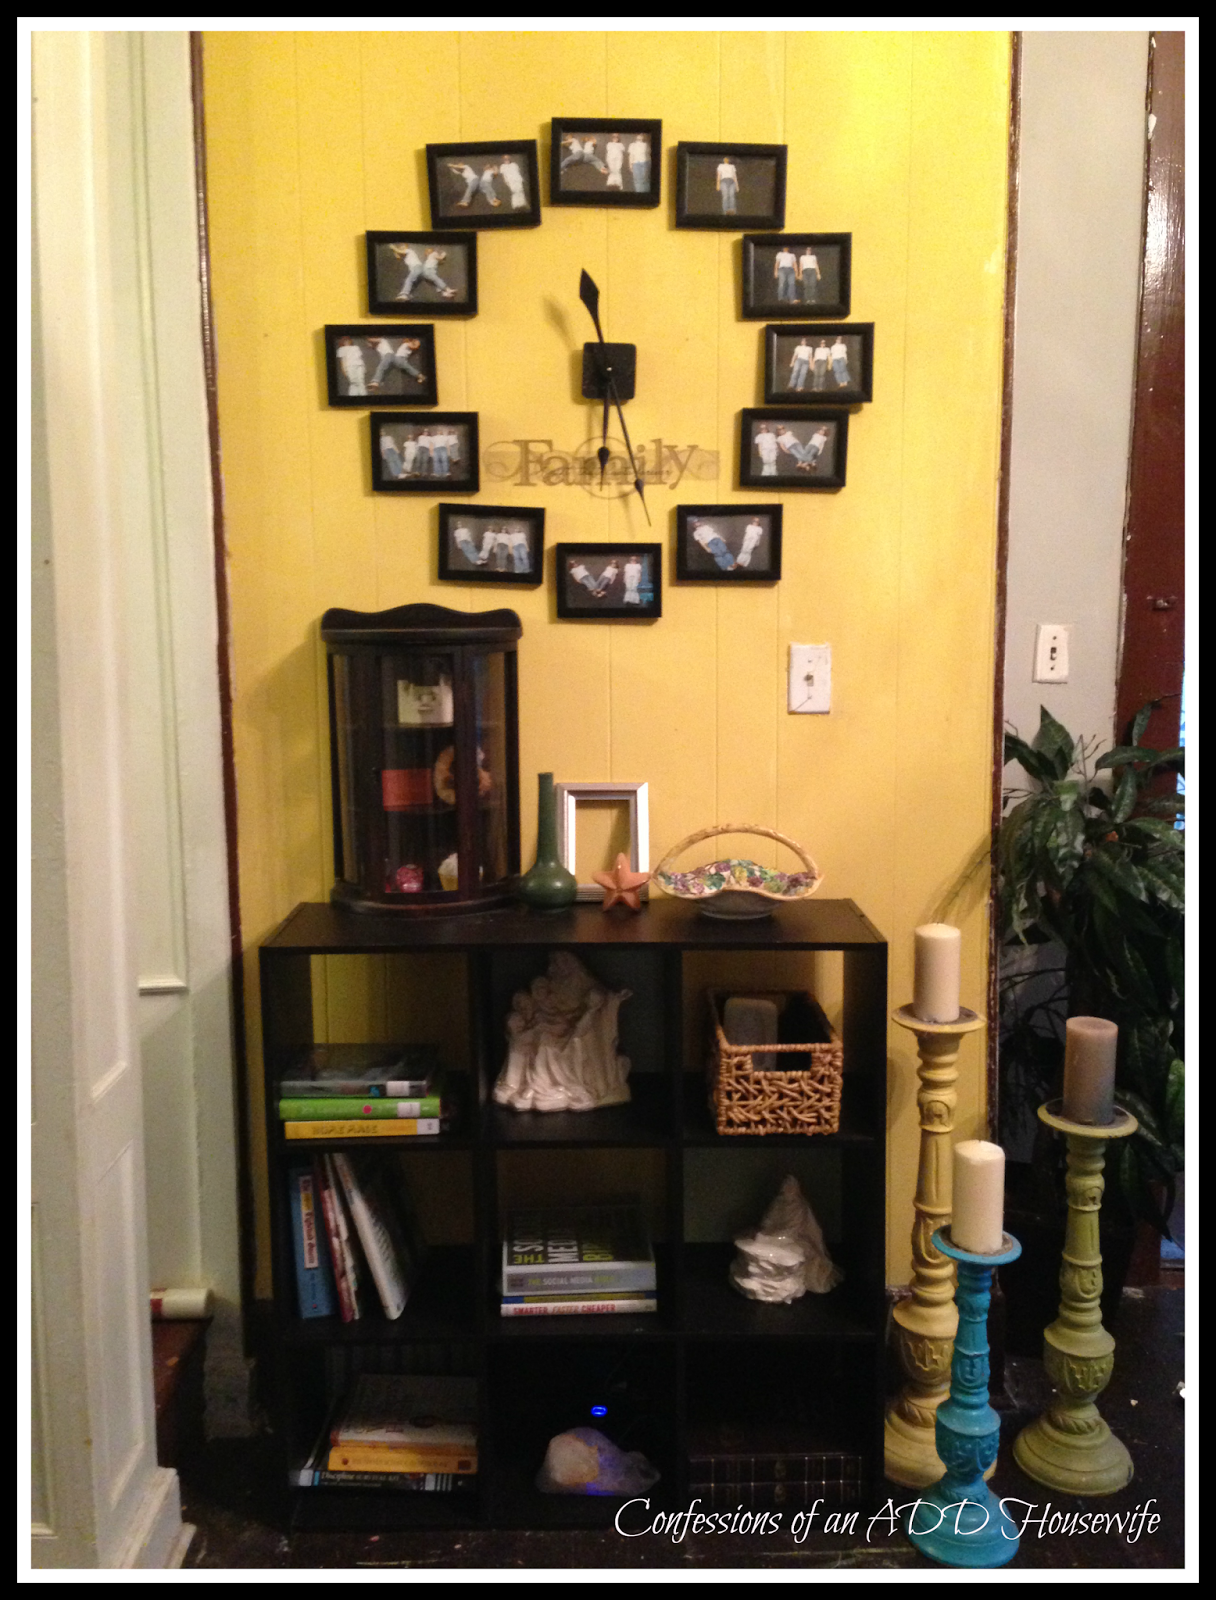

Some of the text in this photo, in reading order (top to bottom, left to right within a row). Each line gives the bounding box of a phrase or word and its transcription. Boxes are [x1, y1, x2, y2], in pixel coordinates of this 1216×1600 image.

[513, 439, 698, 490] Family
[514, 1254, 544, 1265] THE
[543, 1277, 568, 1286] SOCIAL
[570, 1276, 593, 1285] MEDIA
[581, 1304, 616, 1313] CHEAPER
